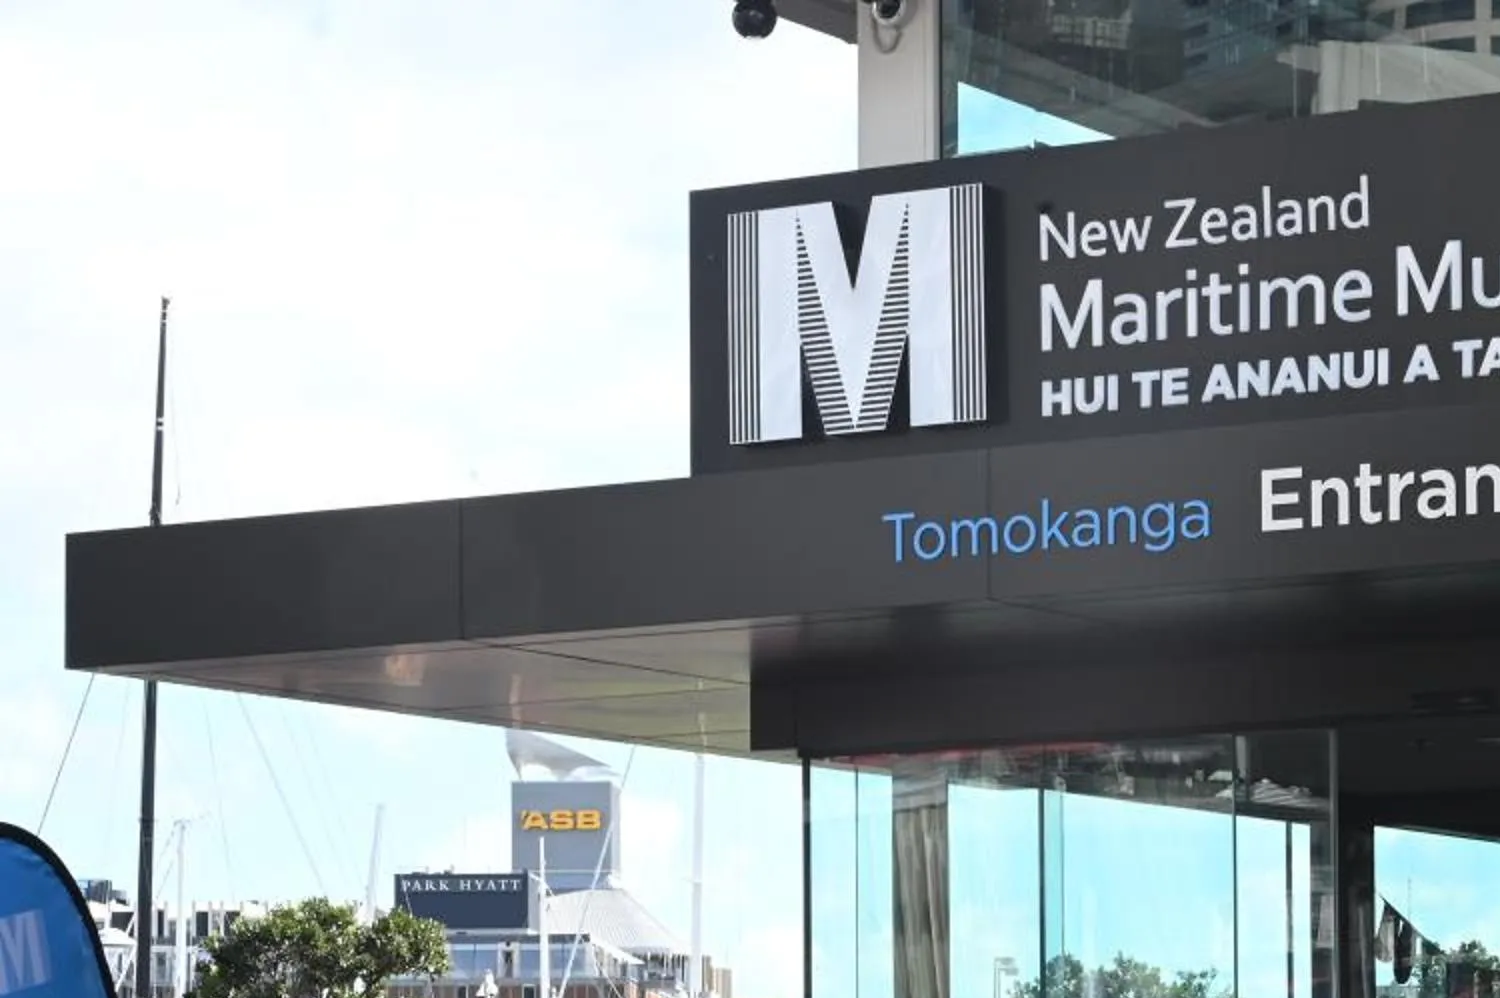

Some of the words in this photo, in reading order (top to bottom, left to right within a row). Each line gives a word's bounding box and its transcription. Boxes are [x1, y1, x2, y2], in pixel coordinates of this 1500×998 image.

[1040, 211, 1152, 261] New
[1164, 174, 1370, 249] Zealand
[727, 182, 987, 445] M
[1040, 263, 1373, 352] Maritime
[1041, 376, 1119, 417] HUI
[1132, 368, 1190, 407] TE
[1202, 348, 1390, 402] ANANUI
[1403, 344, 1440, 384] A
[882, 498, 1212, 564] Tomokanga
[521, 809, 602, 831] ASB
[401, 878, 450, 892] PARK
[460, 878, 522, 892] HYATT
